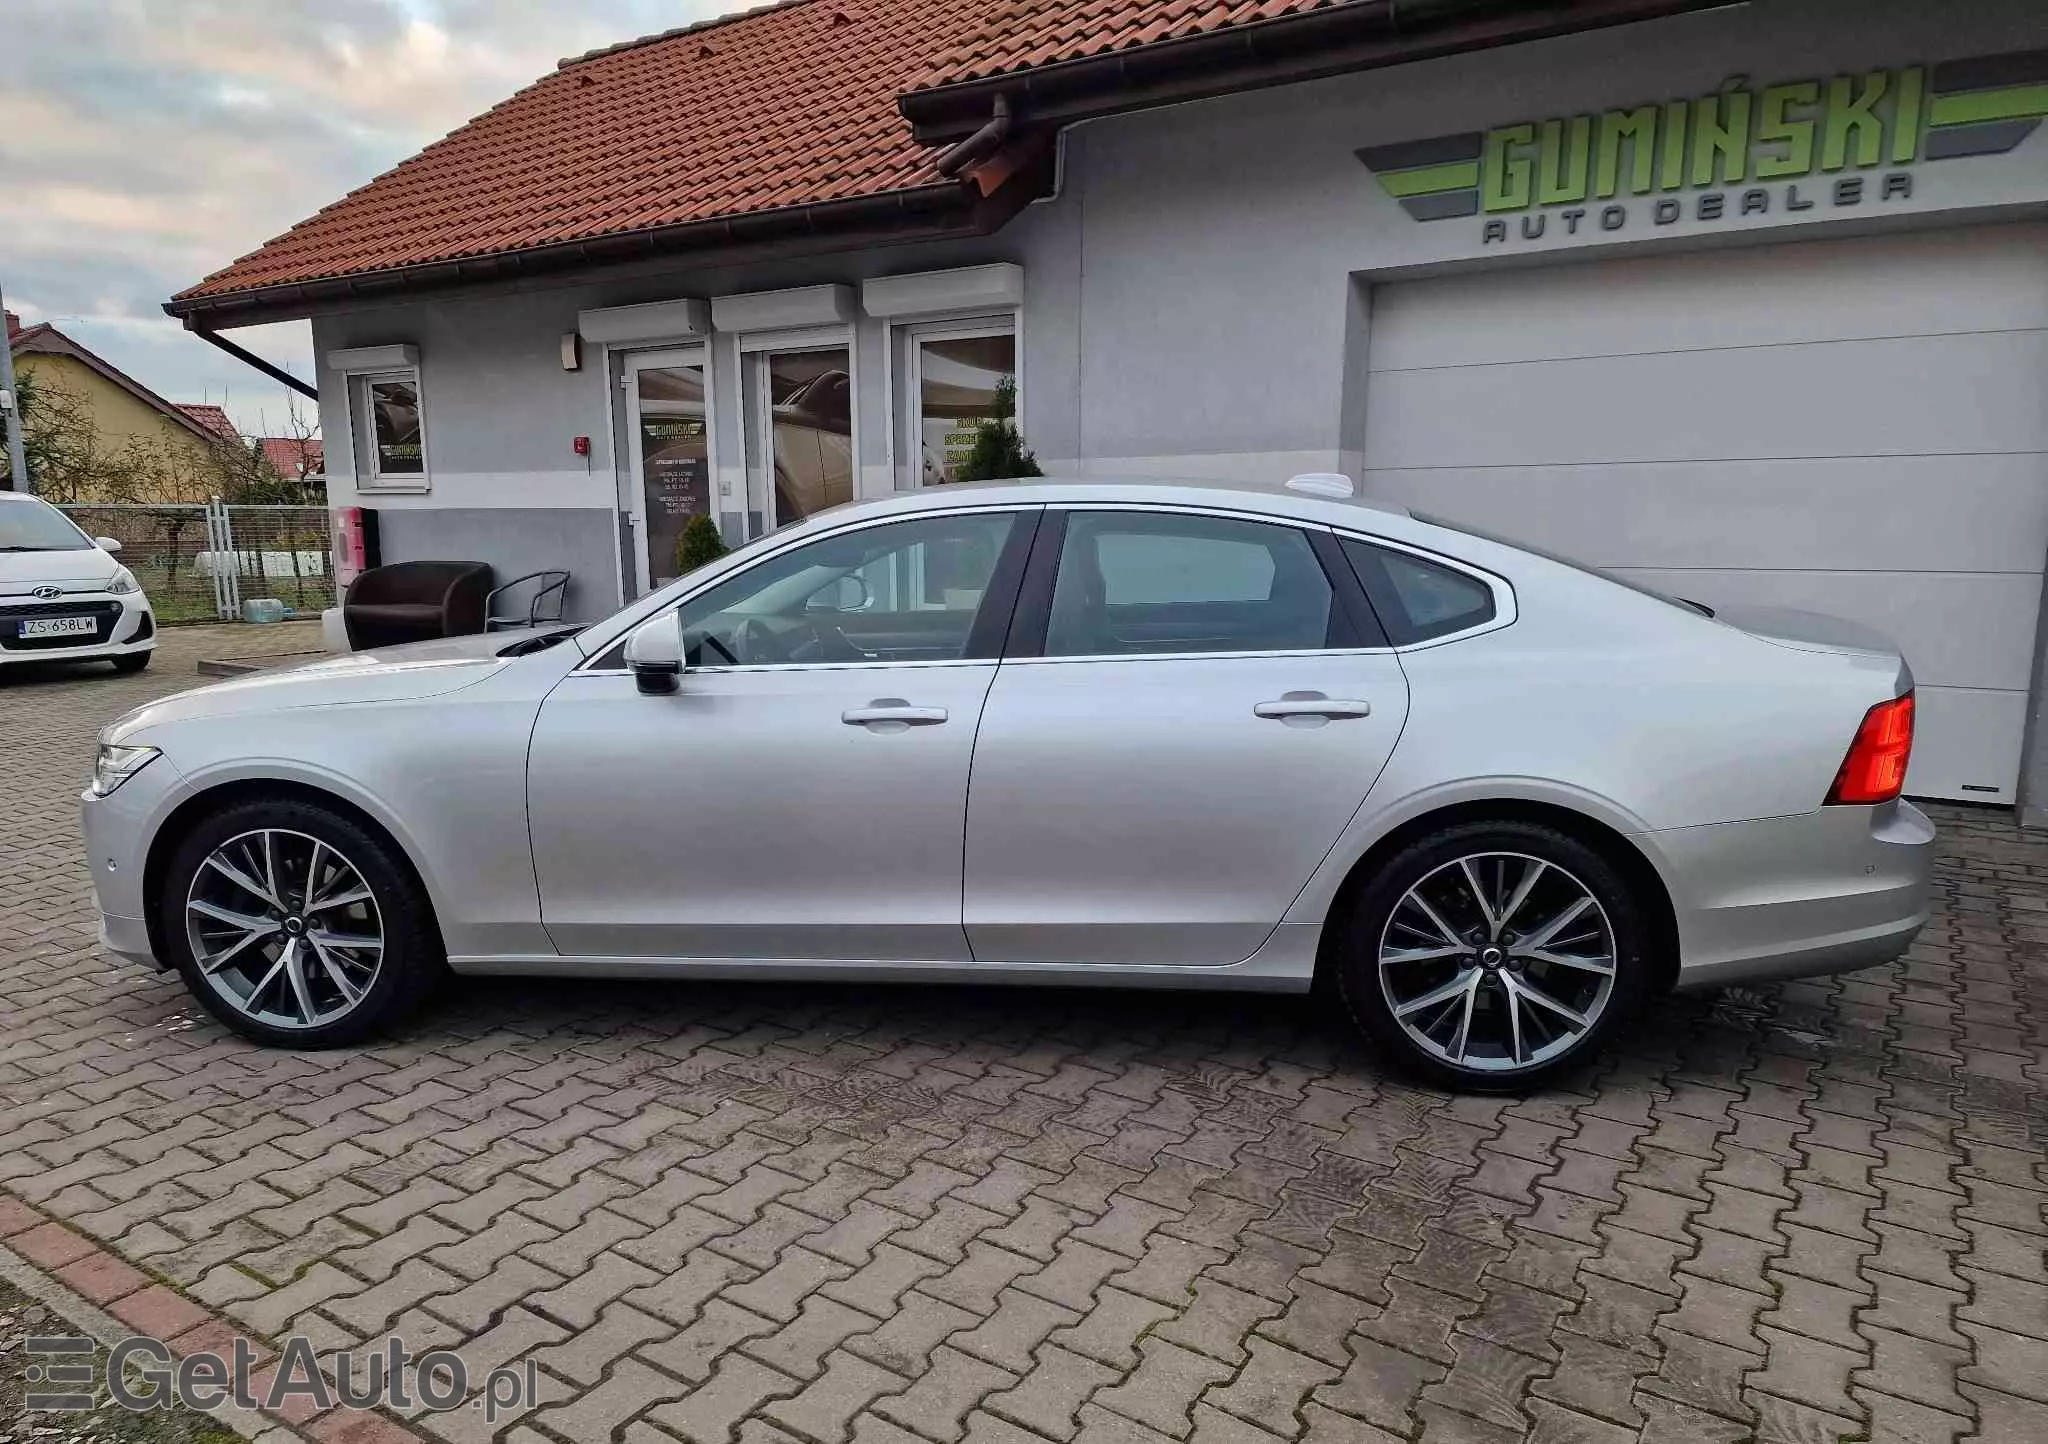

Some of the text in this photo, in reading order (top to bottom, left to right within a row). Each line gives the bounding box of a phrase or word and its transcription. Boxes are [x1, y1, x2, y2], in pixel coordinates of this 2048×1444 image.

[1483, 65, 1926, 213] GUMIŃSKI
[1482, 172, 1914, 244] AUTO DEALER
[29, 622, 46, 634] ZS
[52, 618, 93, 632] 658LW
